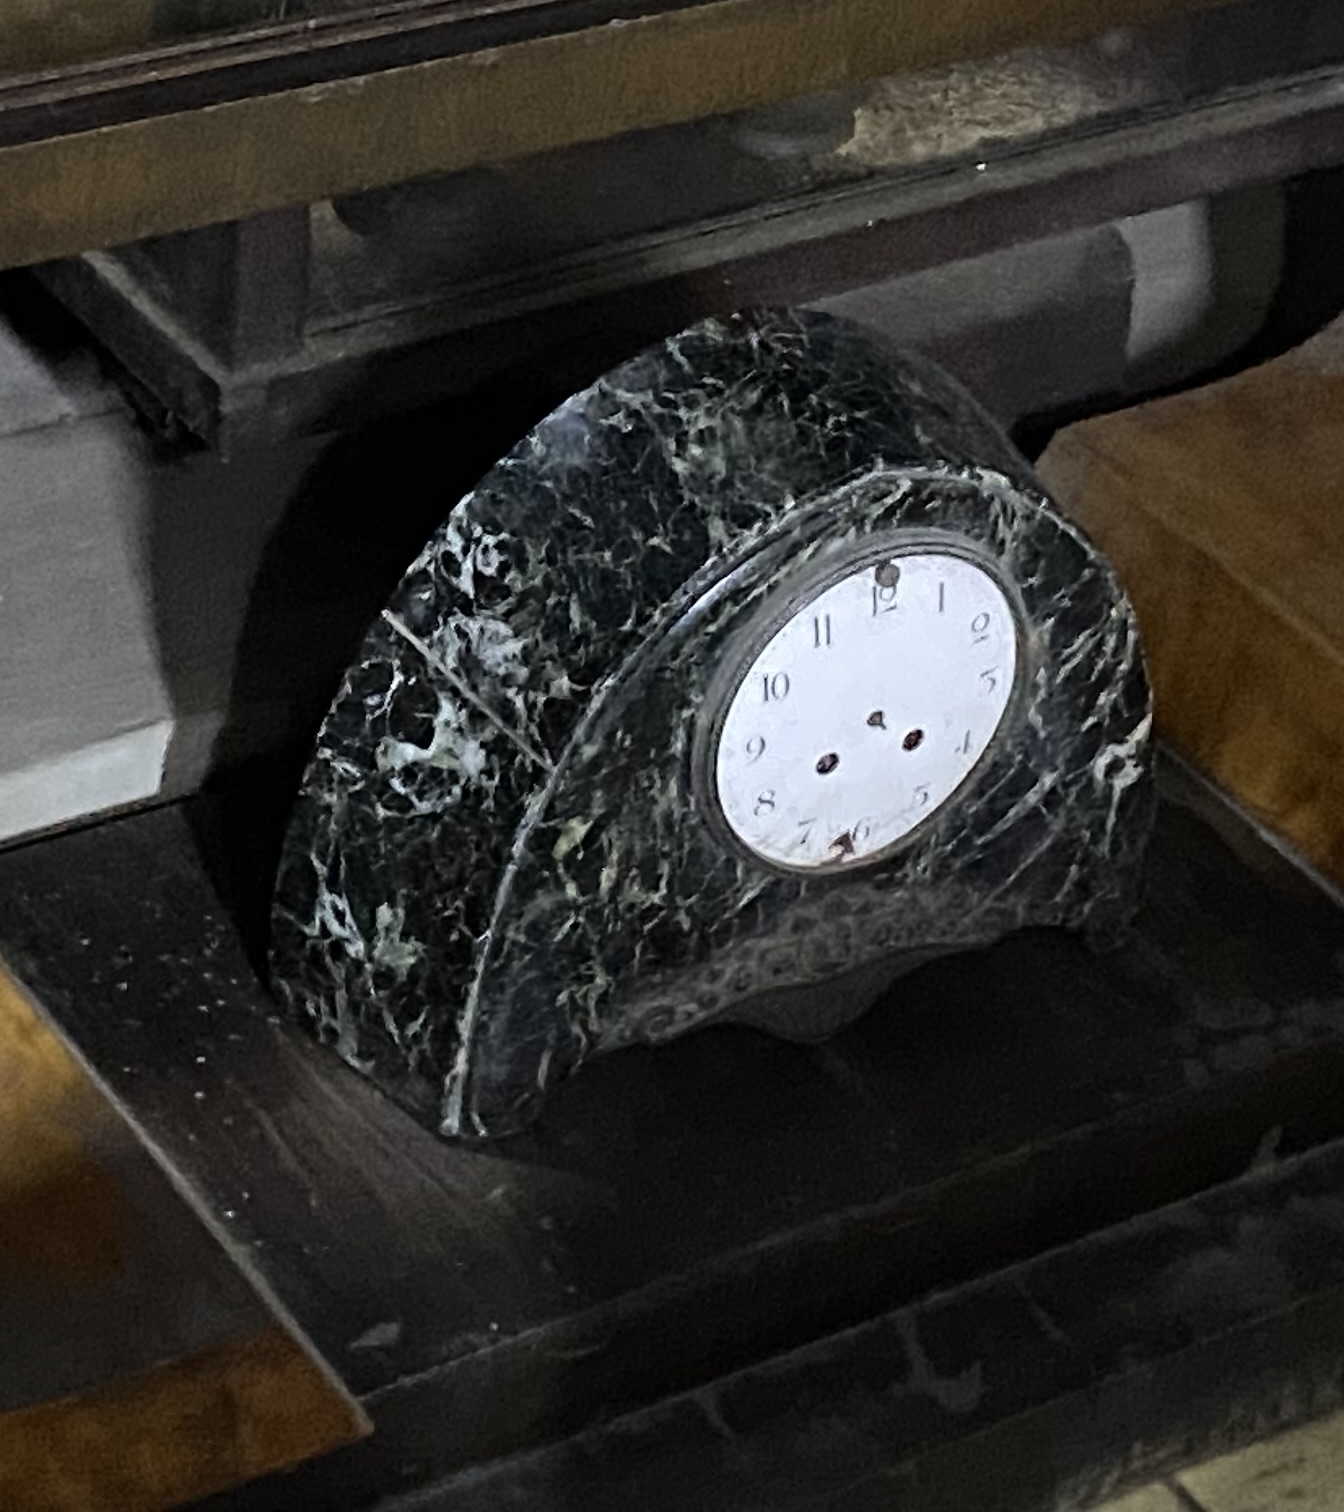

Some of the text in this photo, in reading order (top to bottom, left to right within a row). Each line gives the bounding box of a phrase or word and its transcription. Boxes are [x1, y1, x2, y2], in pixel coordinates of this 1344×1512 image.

[872, 585, 898, 618] 12
[937, 581, 945, 613] 1
[813, 613, 832, 648] 11
[971, 612, 991, 644] 2
[762, 671, 791, 703] 10
[746, 735, 767, 766] 9
[753, 789, 777, 817] 8
[797, 817, 817, 845] 7
